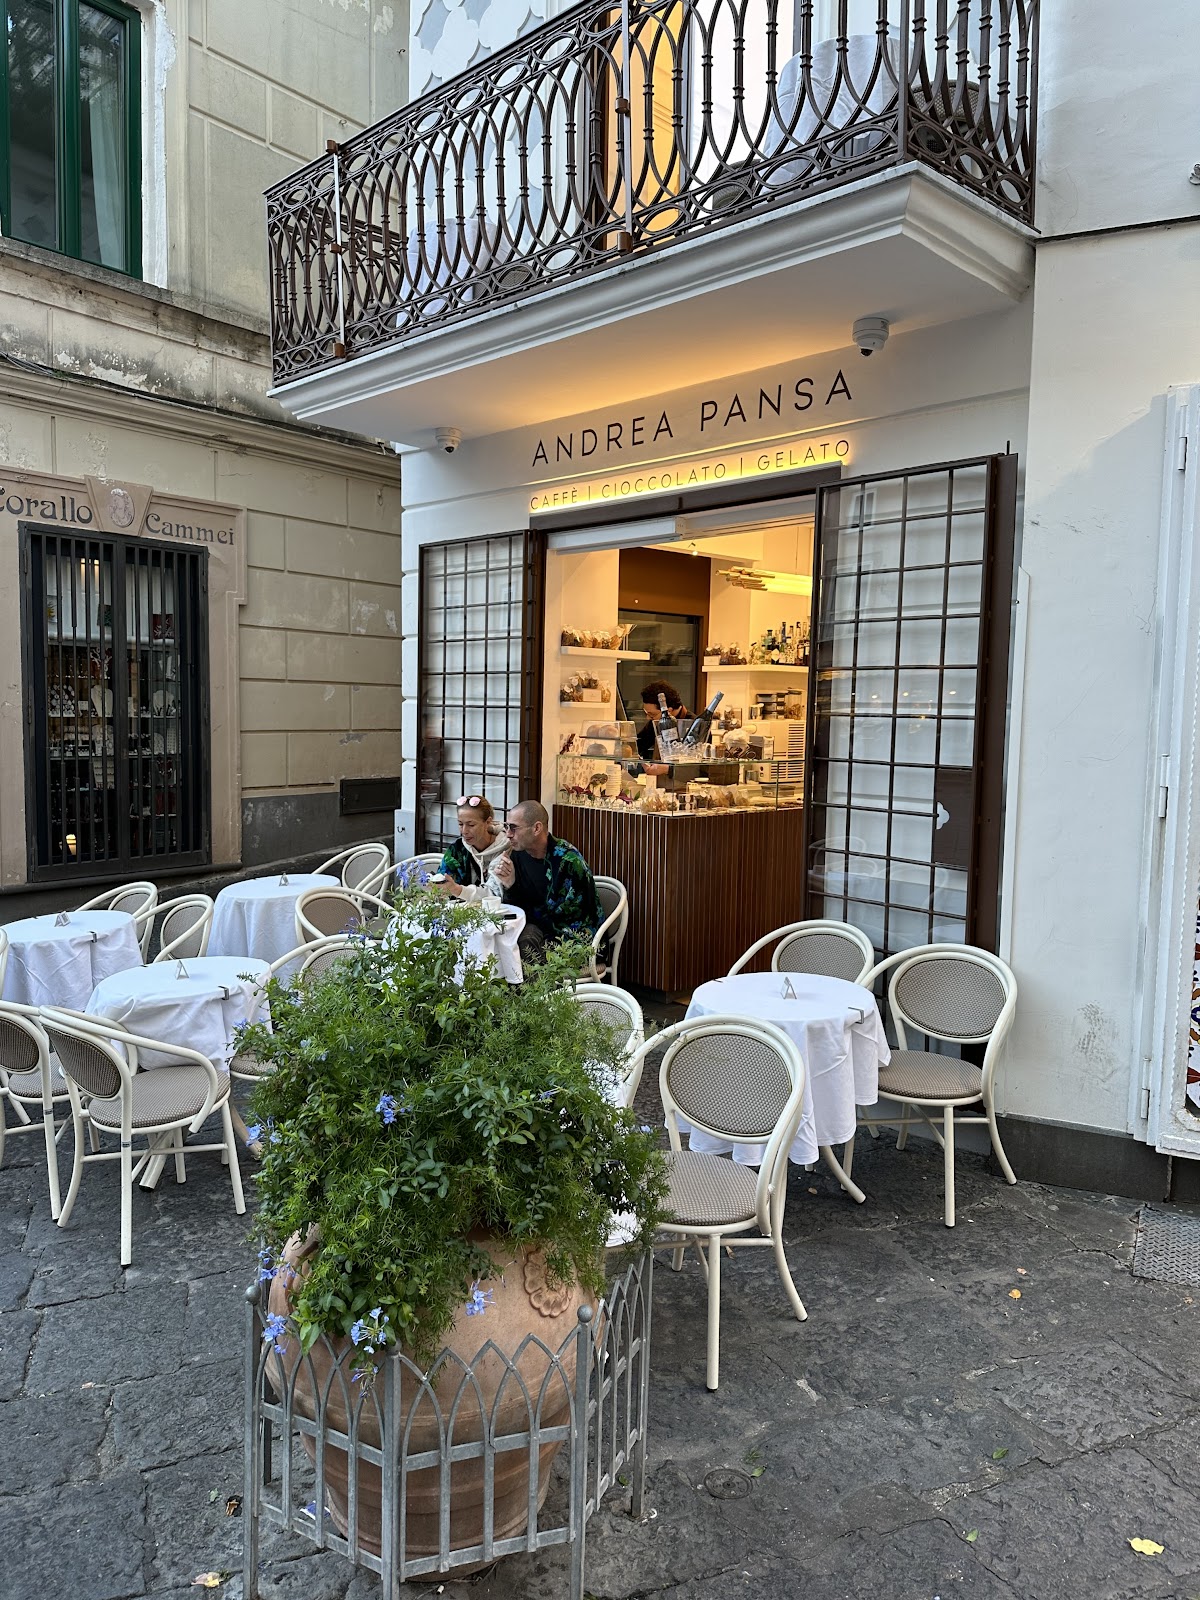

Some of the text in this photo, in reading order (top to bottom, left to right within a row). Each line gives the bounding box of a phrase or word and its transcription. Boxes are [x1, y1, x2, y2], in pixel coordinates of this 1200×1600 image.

[532, 369, 853, 467] ANDREA PANSA
[530, 487, 578, 511] CAFFÈ
[602, 463, 725, 498] CIOCCOLATO
[757, 439, 850, 471] GELATO
[0, 486, 235, 546] orallo Cammei
